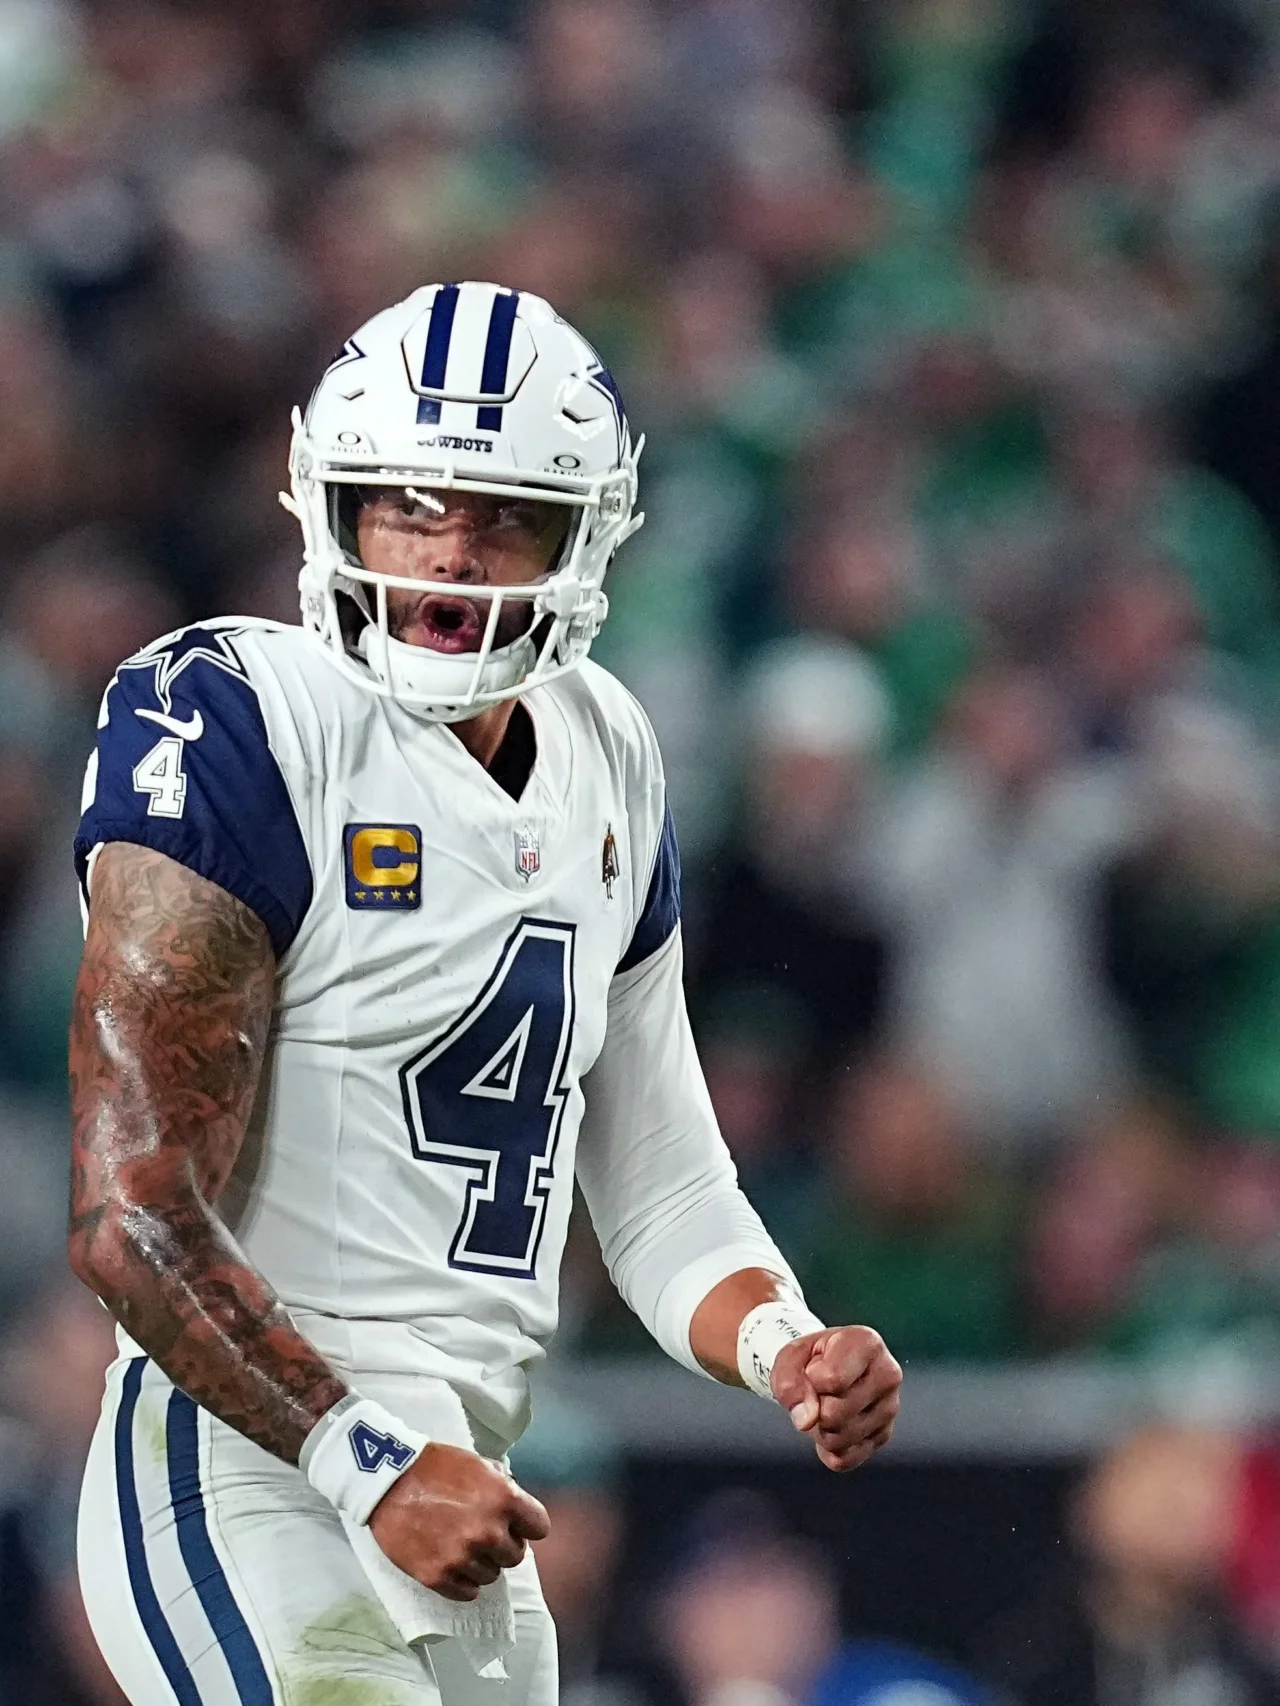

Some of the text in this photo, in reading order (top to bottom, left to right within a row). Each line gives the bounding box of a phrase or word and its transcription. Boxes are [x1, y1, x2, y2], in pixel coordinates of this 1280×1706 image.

[132, 736, 187, 819] 4
[350, 826, 419, 887] C
[398, 916, 577, 1280] 4
[348, 1419, 416, 1473] 4
